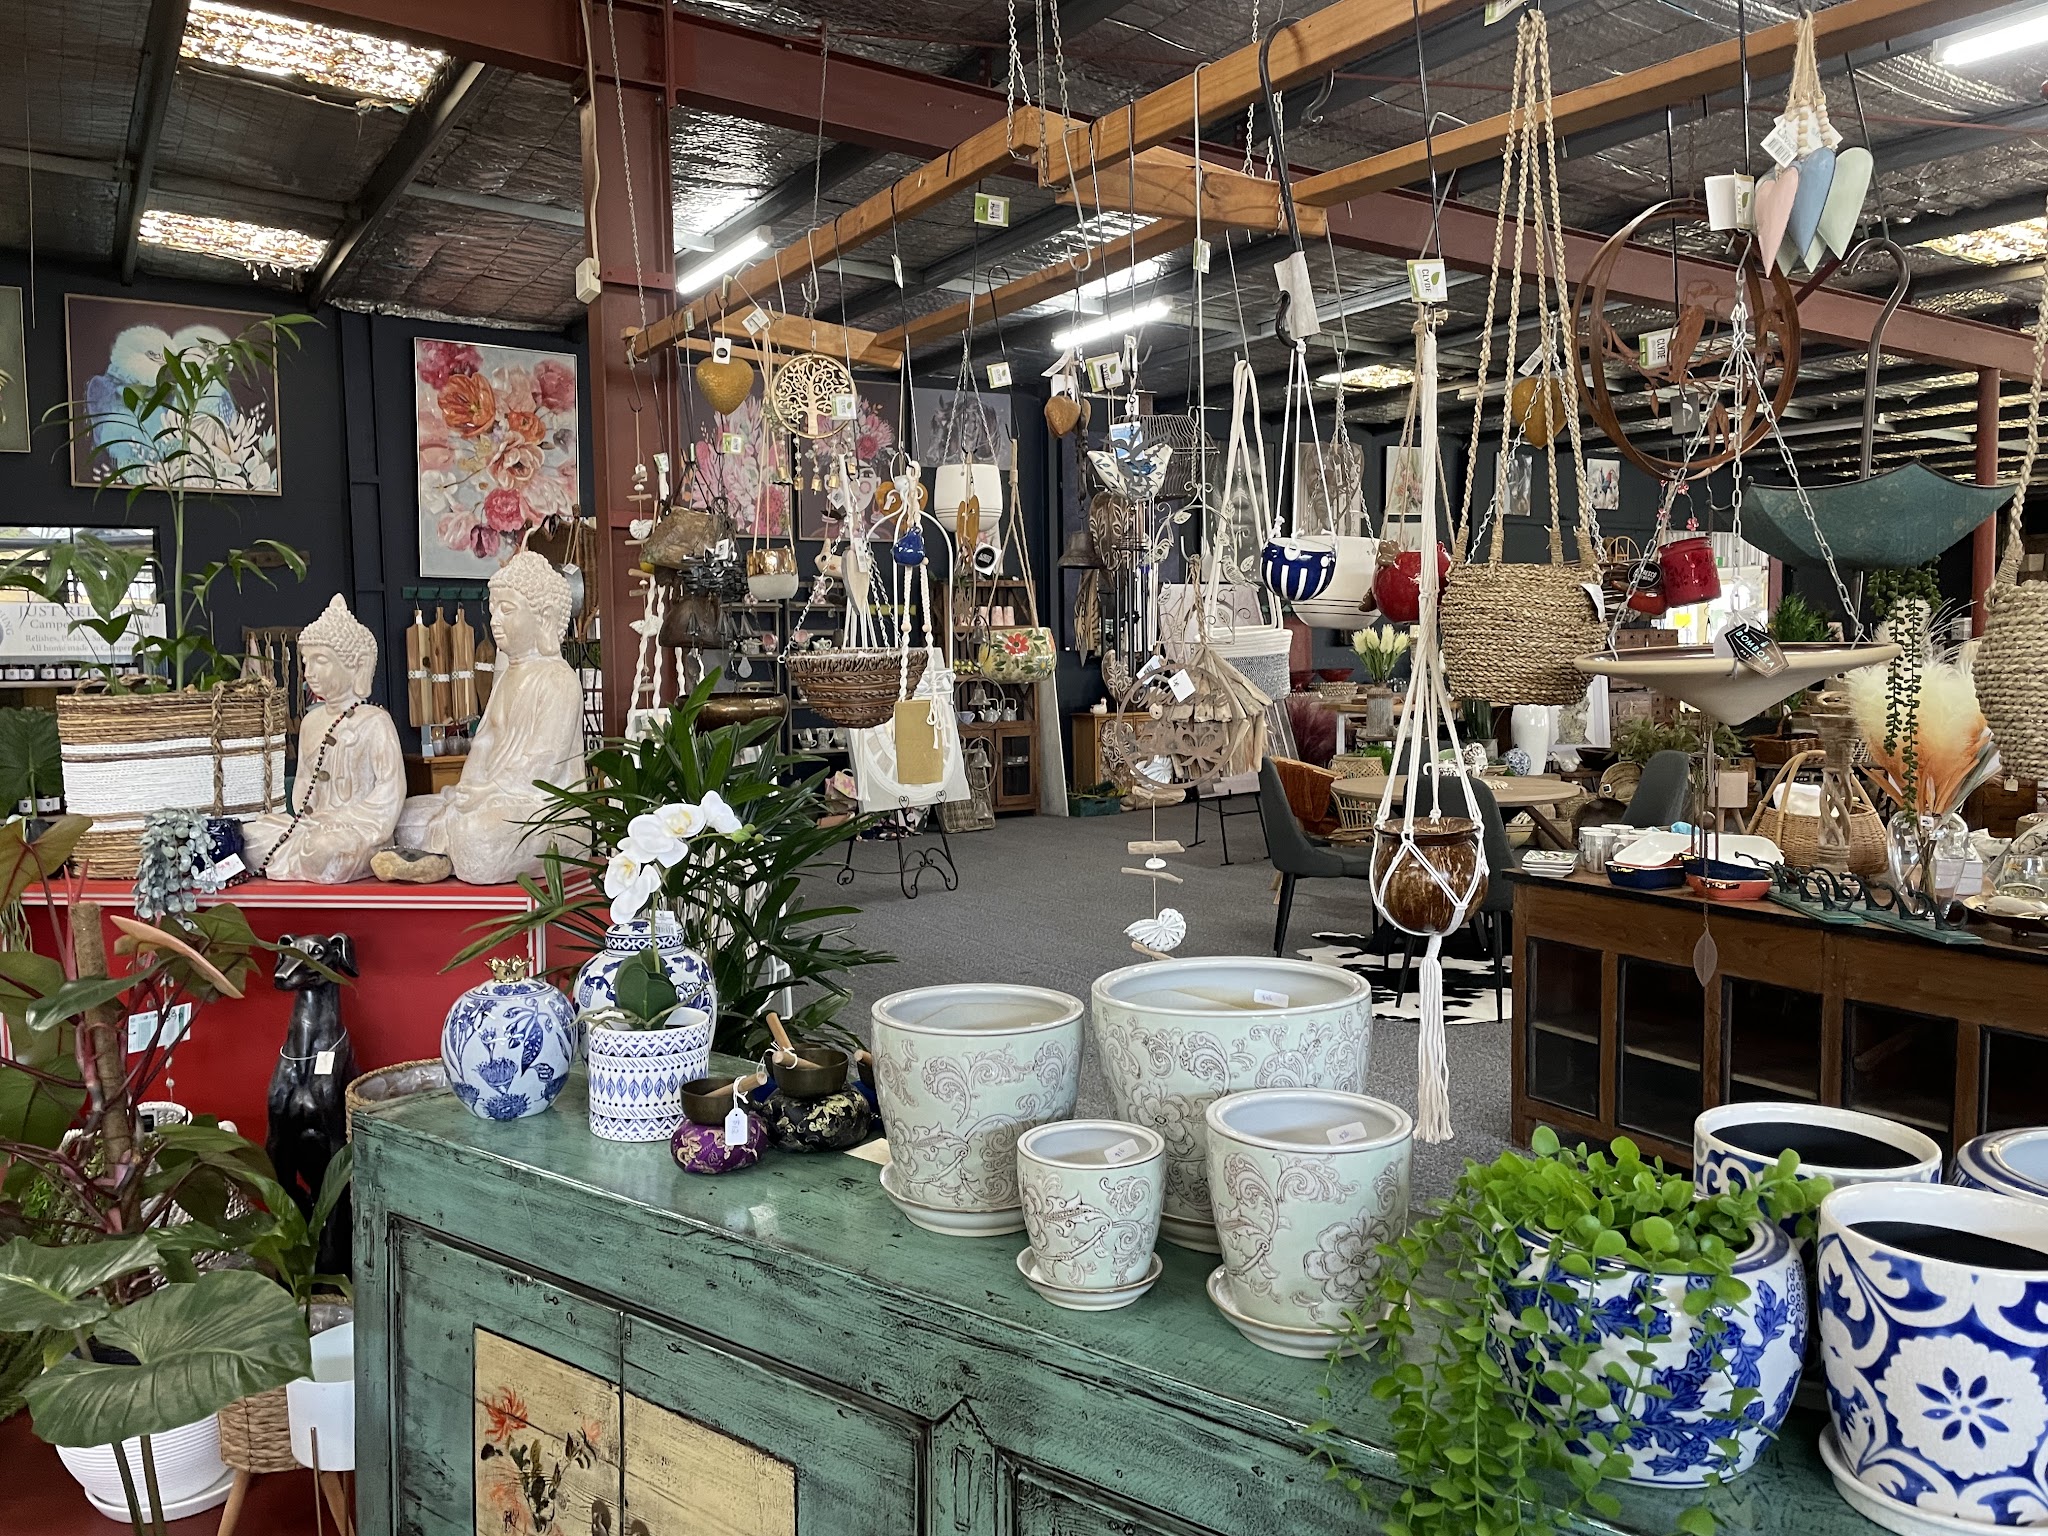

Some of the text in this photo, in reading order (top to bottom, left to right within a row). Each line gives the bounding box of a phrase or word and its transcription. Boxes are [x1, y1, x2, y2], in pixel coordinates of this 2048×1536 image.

[1421, 268, 1432, 294] CLYDE
[1656, 338, 1666, 360] CLYDE
[18, 605, 60, 620] JUST
[31, 644, 42, 652] All
[44, 644, 66, 652] home
[1735, 630, 1775, 668] BOMBORA
